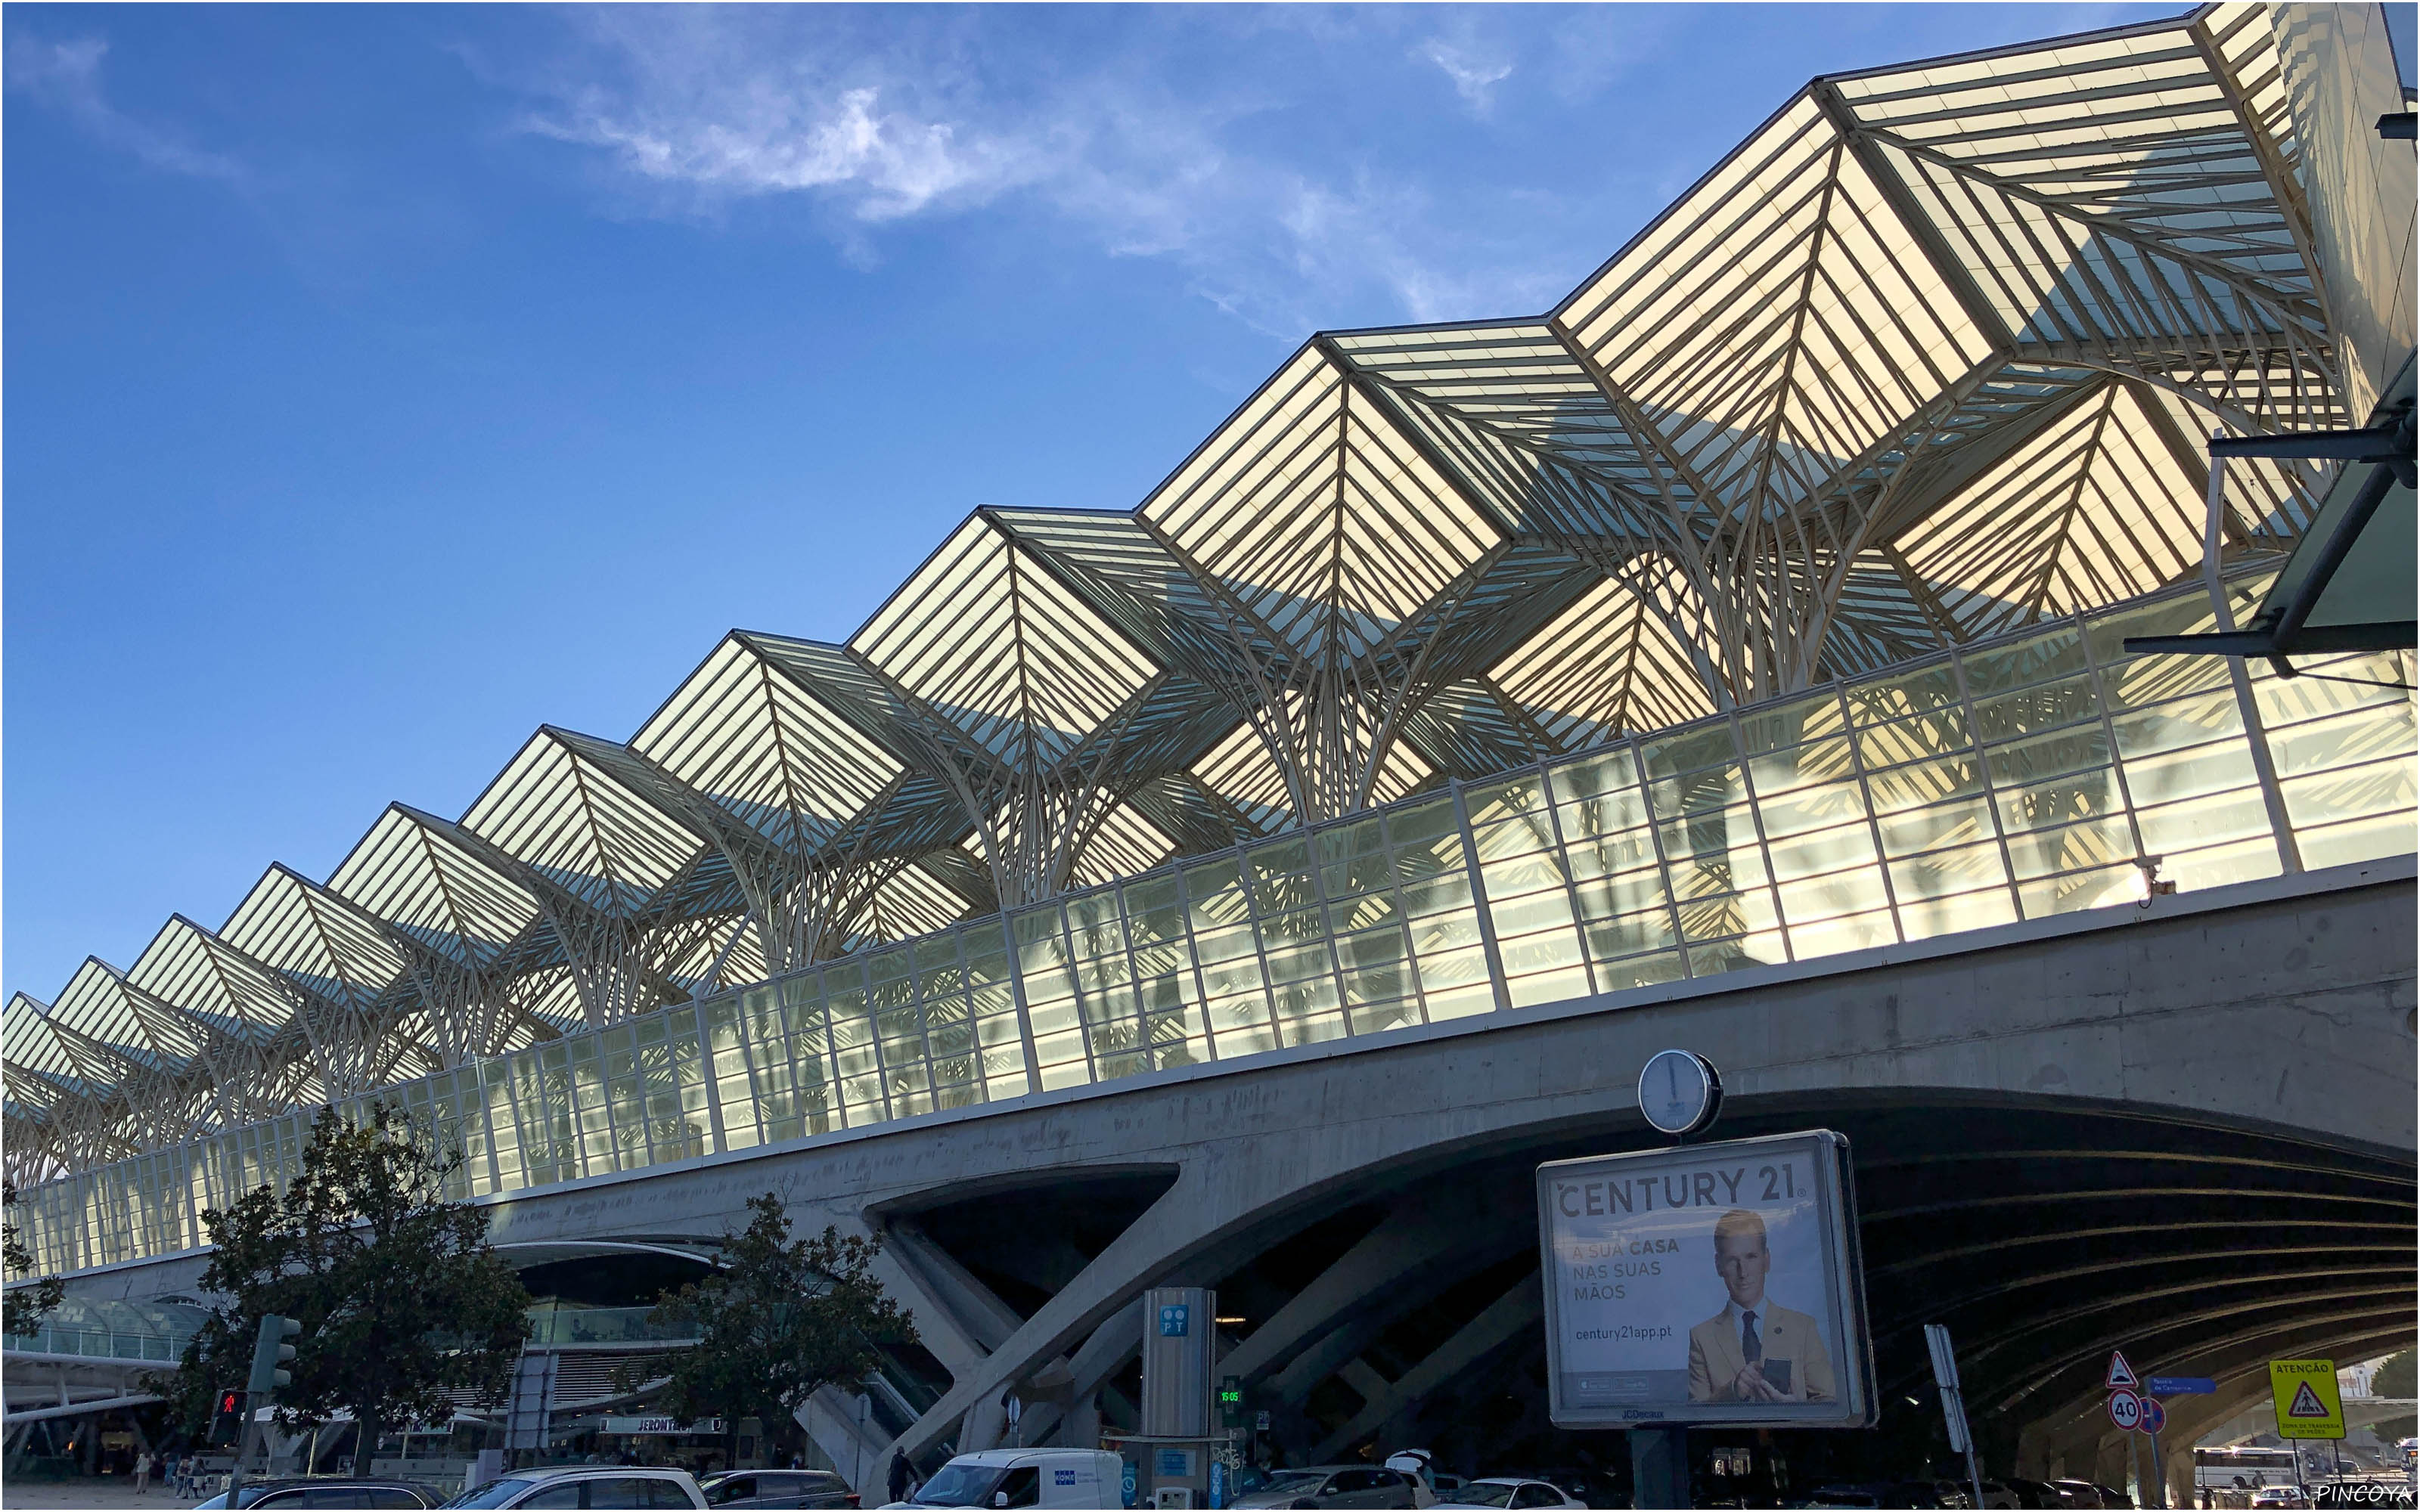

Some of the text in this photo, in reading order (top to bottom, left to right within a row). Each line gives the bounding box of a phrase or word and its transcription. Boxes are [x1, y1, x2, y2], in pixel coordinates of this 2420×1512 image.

[1558, 1168, 1745, 1217] CENTURY
[1572, 1238, 1680, 1259] A SUA CASA
[1573, 1261, 1661, 1280] NAS SUAS
[1575, 1282, 1625, 1301] MÃOS
[1575, 1325, 1672, 1342] century21app.pt
[2276, 1362, 2328, 1374] ATENÇÃO
[1621, 1409, 1665, 1420] JCDecaux
[2115, 1402, 2136, 1418] 40
